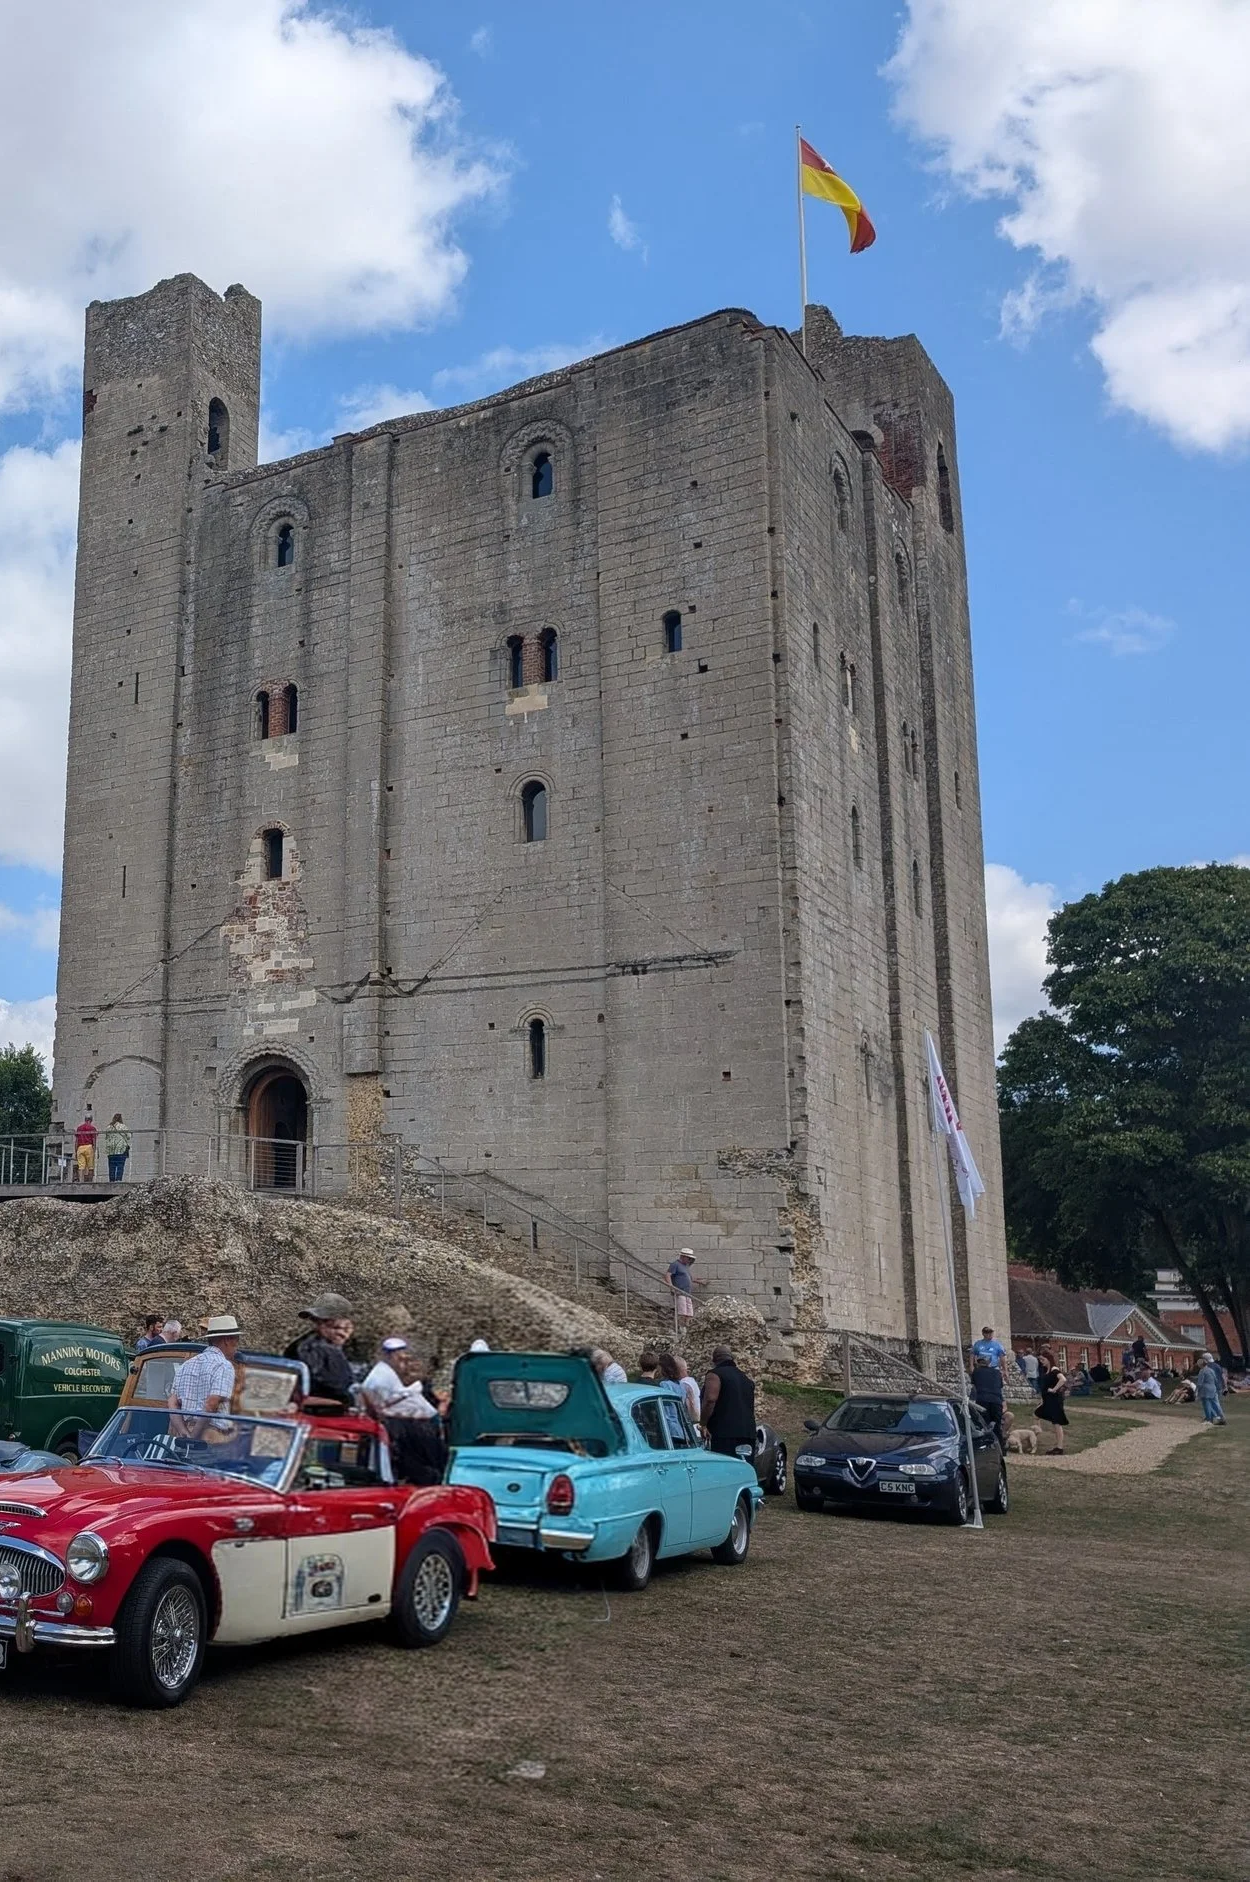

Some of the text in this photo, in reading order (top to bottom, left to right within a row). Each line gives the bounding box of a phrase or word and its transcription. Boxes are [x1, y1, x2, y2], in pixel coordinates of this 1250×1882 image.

[41, 1346, 121, 1371] MANNING MOTORS
[64, 1367, 101, 1377] COLCHESTER
[53, 1383, 112, 1393] VEHICLE RECOVERY
